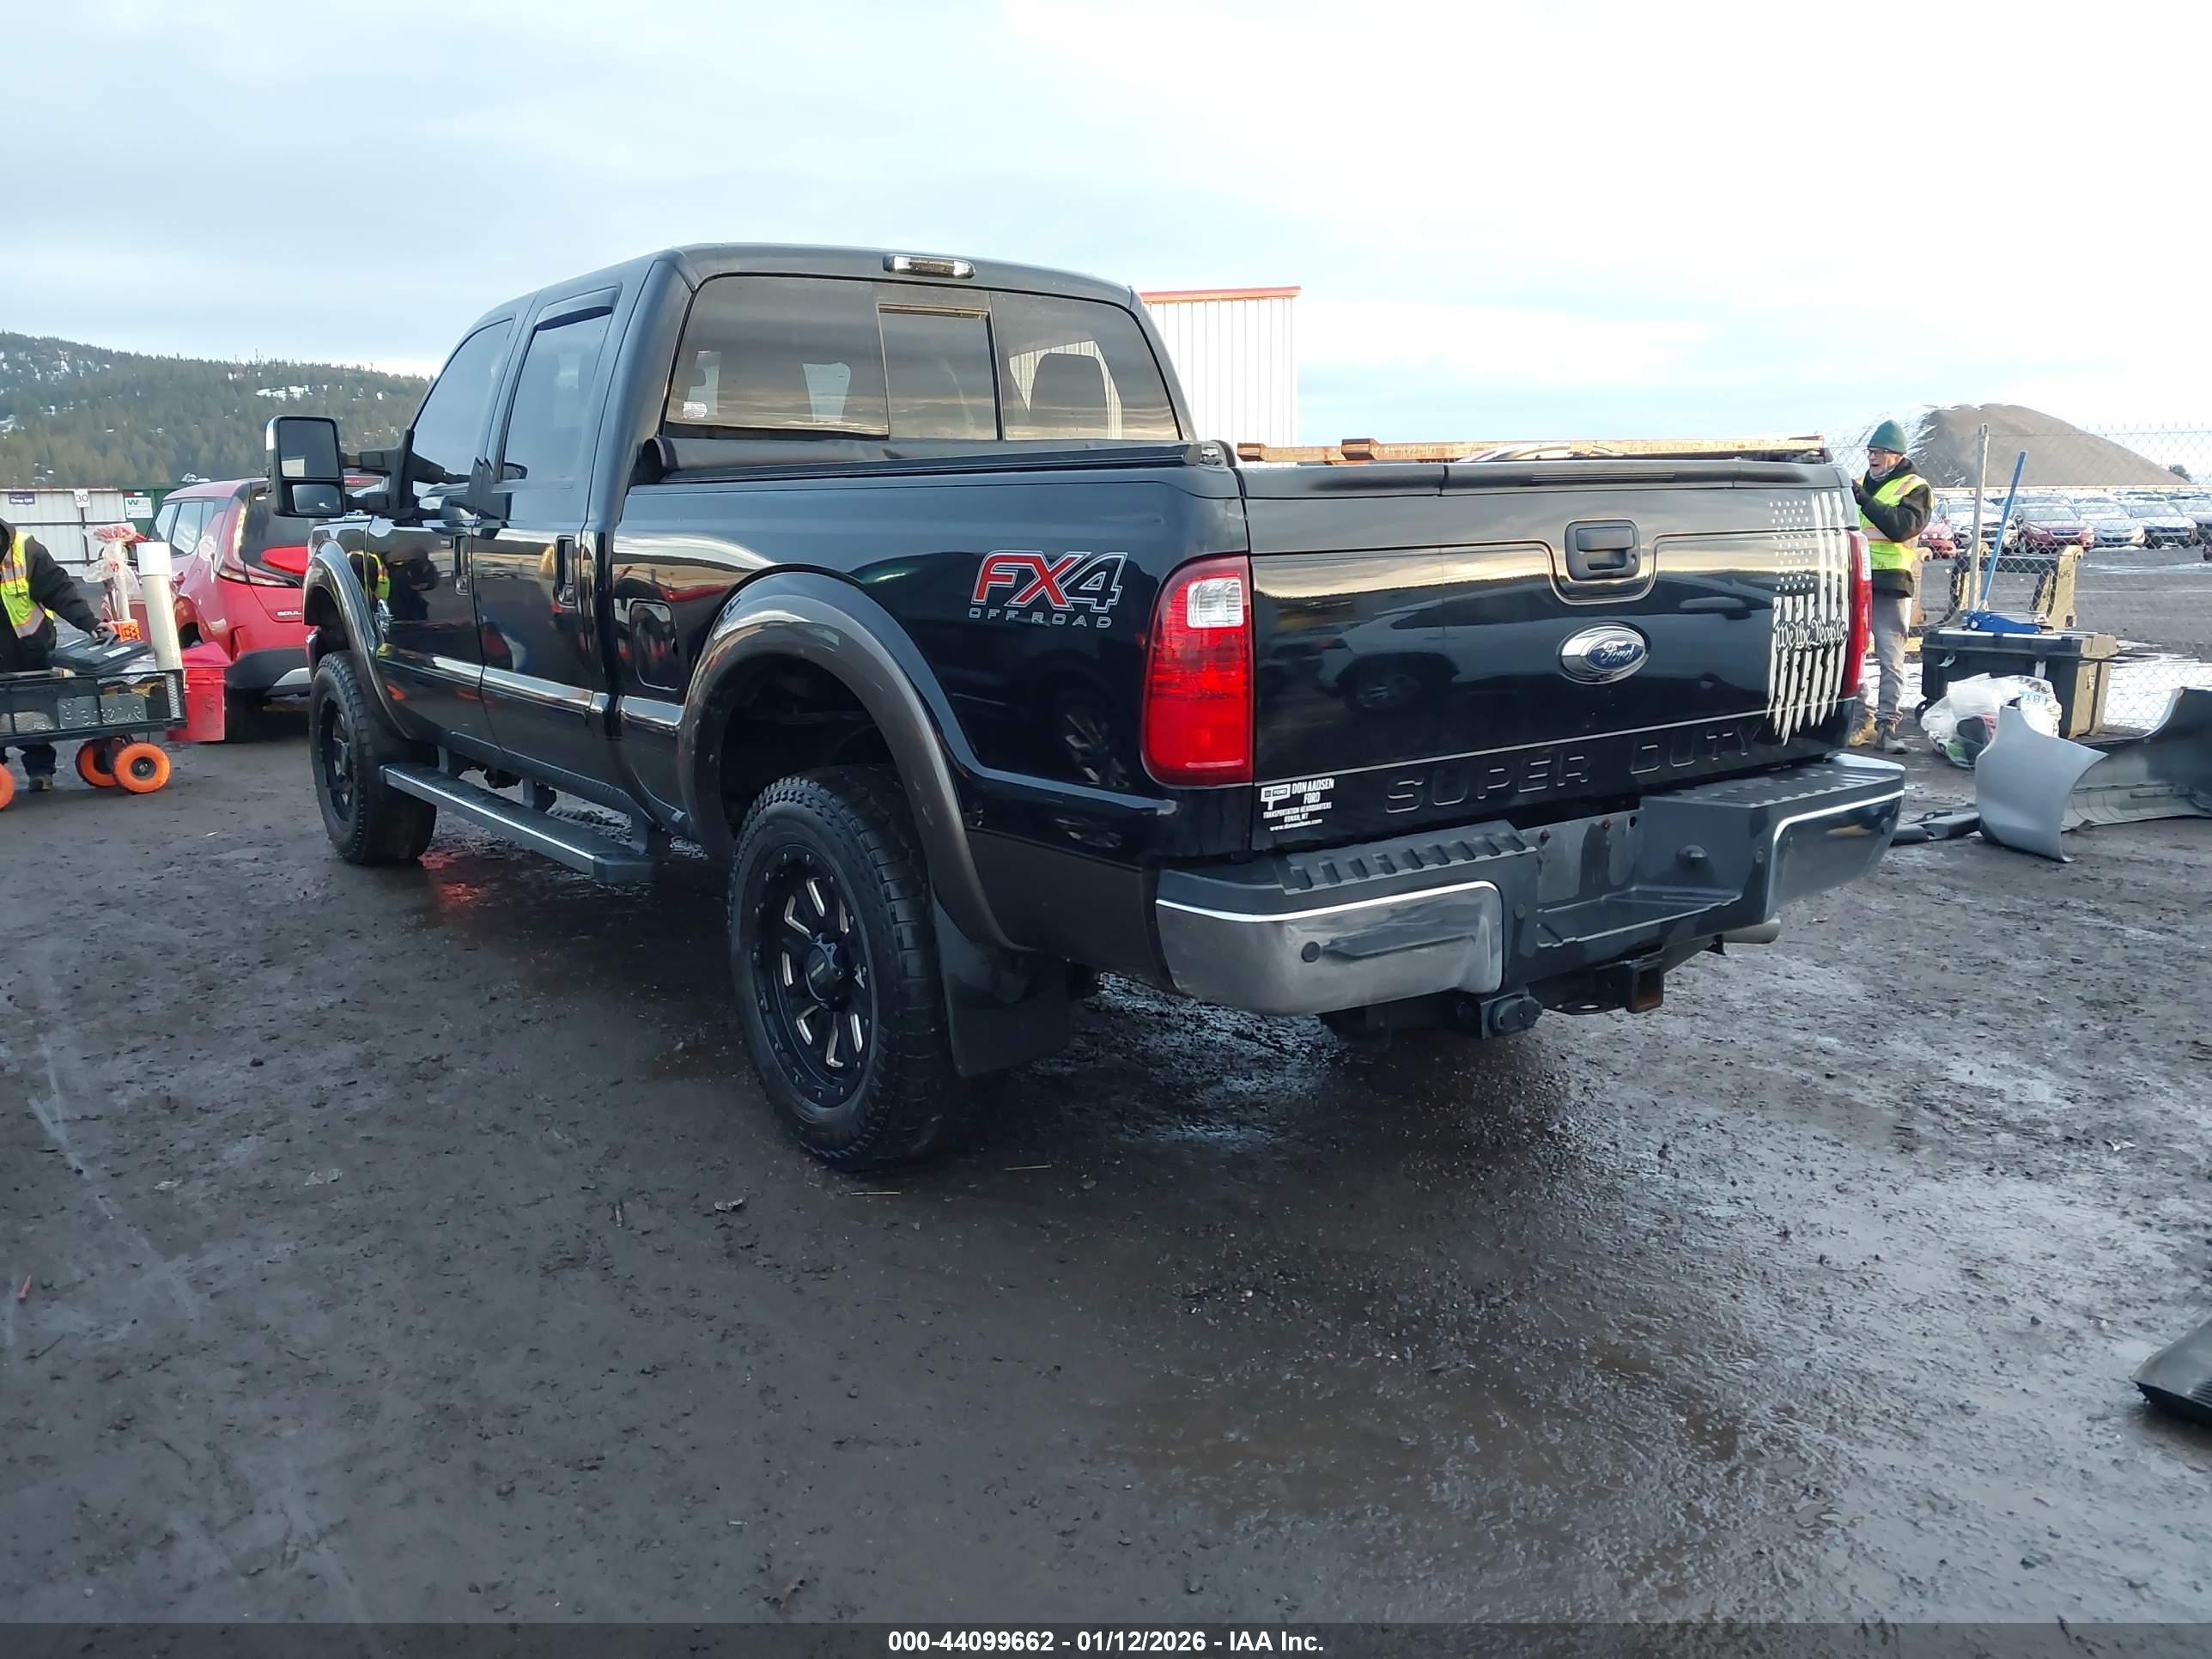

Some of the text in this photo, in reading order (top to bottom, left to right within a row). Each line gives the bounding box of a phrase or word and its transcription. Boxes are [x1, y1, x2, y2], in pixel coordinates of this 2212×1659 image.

[76, 494, 89, 502] 30
[970, 549, 1128, 614] FX4
[969, 607, 1112, 629] OFF ROAD
[1808, 616, 1847, 652] People
[1600, 640, 1635, 662] Ford
[1385, 722, 1762, 813] SUPER DUTY
[1291, 779, 1334, 794] DON AADSEN
[1303, 792, 1322, 805] FORD
